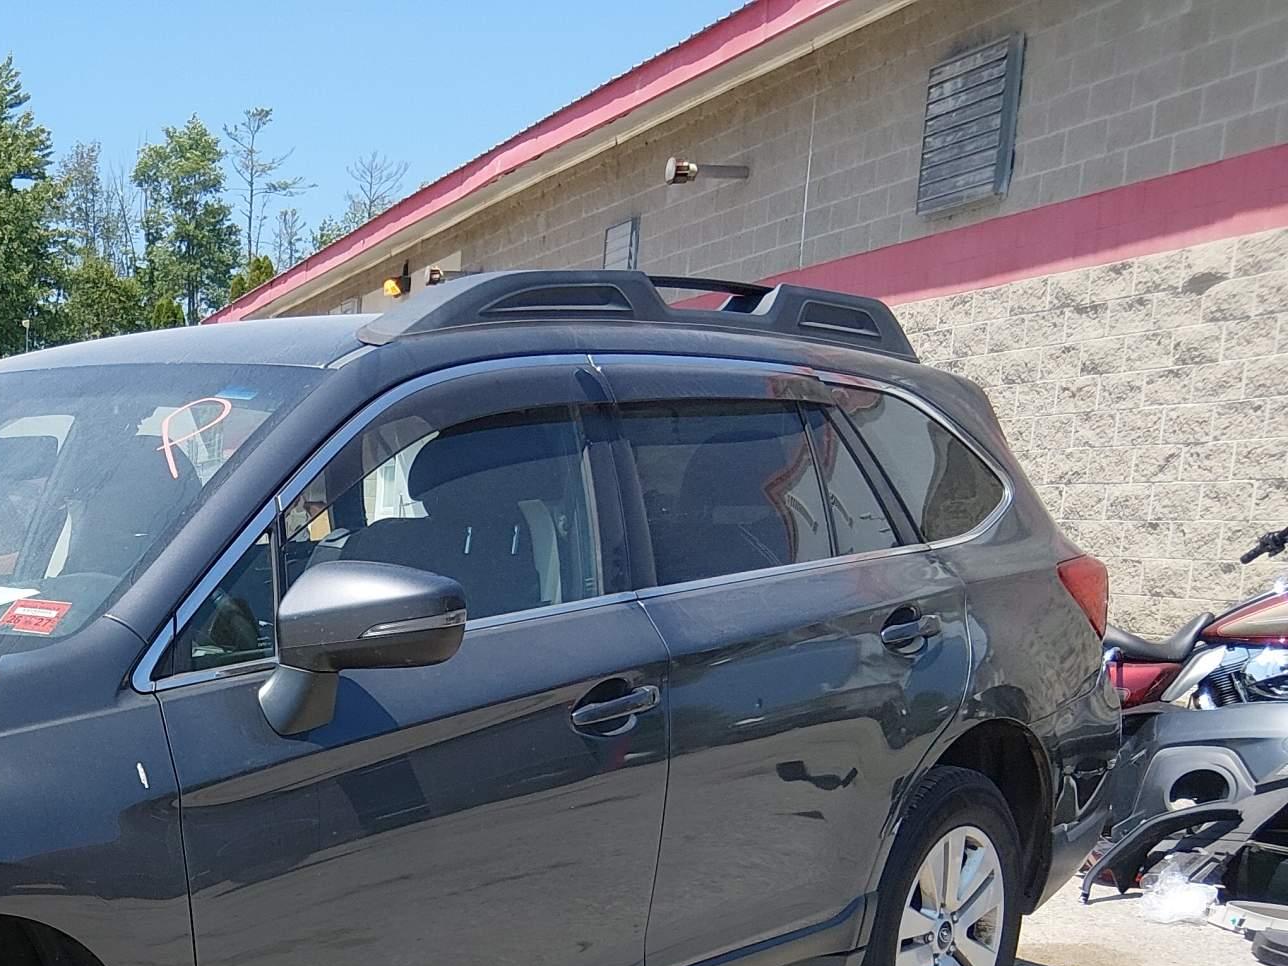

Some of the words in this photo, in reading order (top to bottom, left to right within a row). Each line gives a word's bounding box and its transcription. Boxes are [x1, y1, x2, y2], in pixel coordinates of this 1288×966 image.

[156, 397, 232, 480] P
[6, 614, 23, 625] 26
[34, 617, 51, 628] 27
